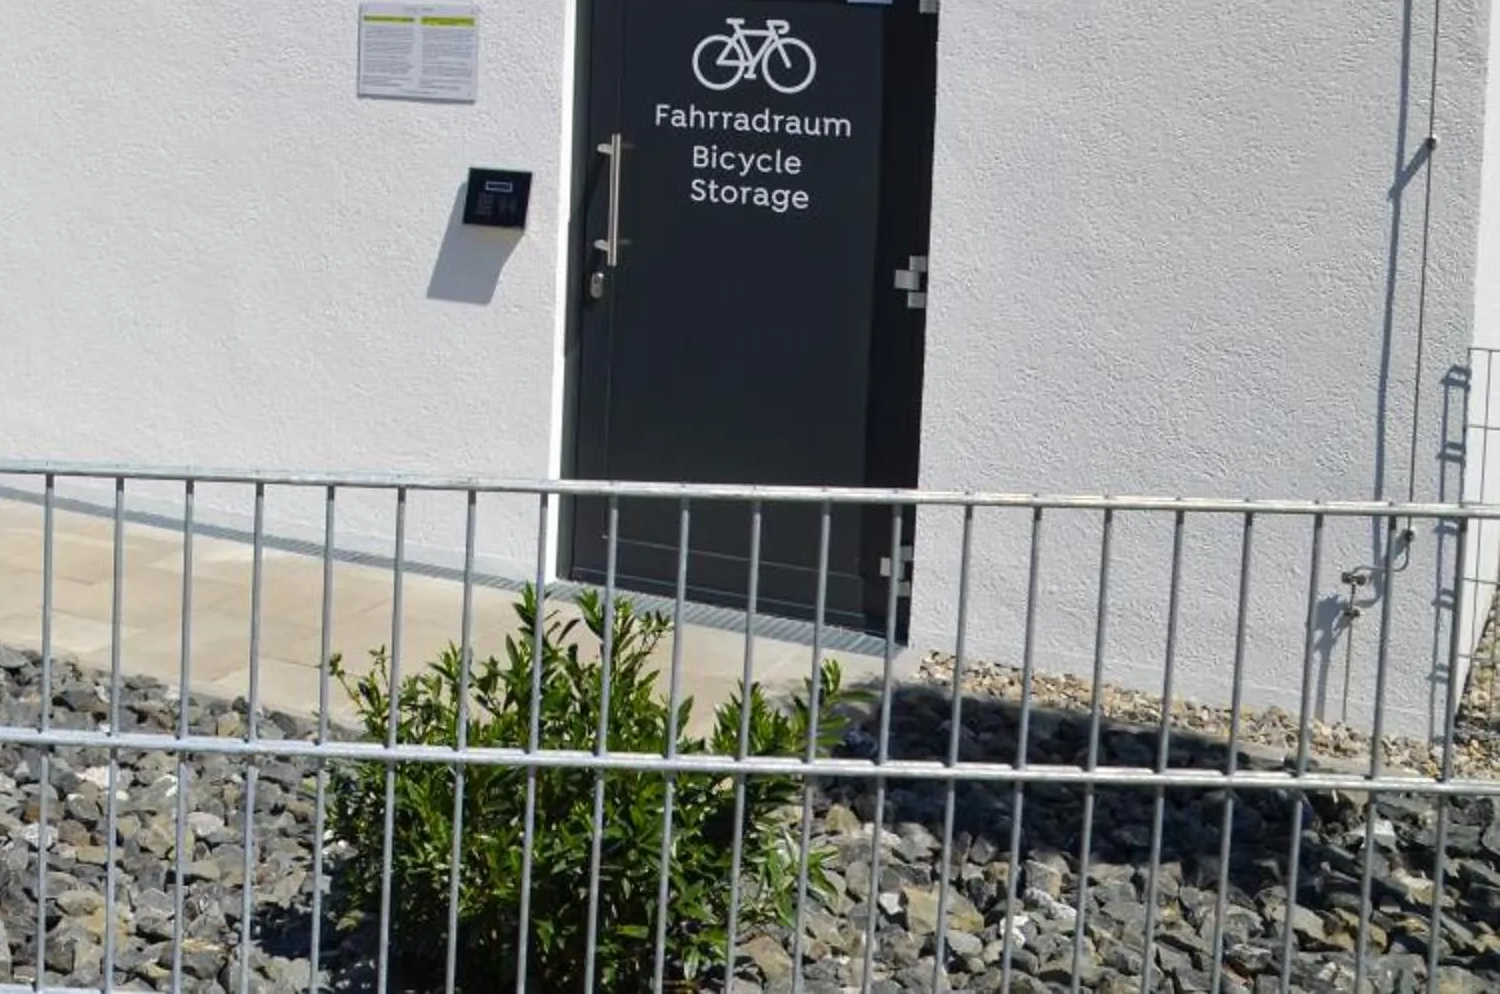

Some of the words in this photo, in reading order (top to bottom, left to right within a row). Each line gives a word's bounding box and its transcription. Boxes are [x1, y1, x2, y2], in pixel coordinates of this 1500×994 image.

[655, 103, 852, 138] Fahrradraum
[692, 144, 803, 176] Bicycle
[690, 178, 810, 213] Storage
